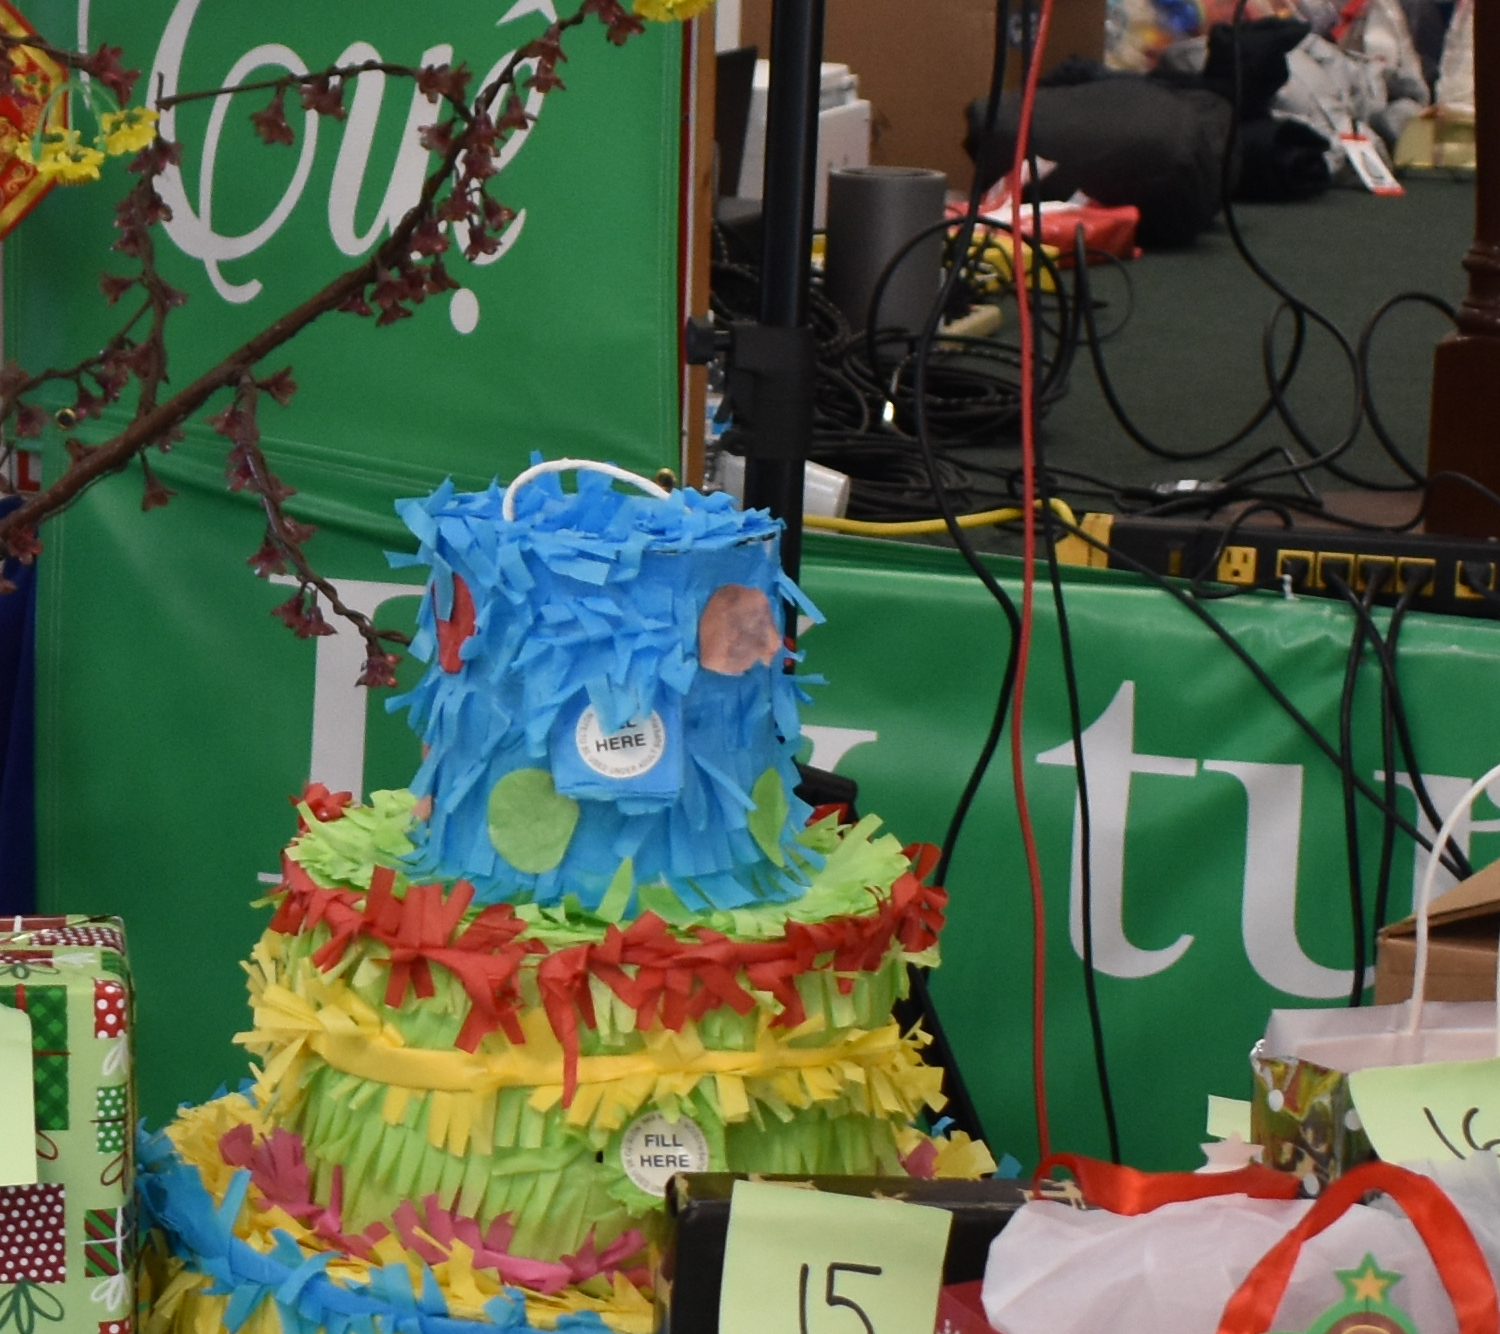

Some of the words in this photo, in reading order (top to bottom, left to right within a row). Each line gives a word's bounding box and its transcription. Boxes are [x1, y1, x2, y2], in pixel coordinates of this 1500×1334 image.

[595, 733, 647, 752] HERE
[645, 1134, 684, 1148] FILL
[640, 1154, 690, 1168] HERE
